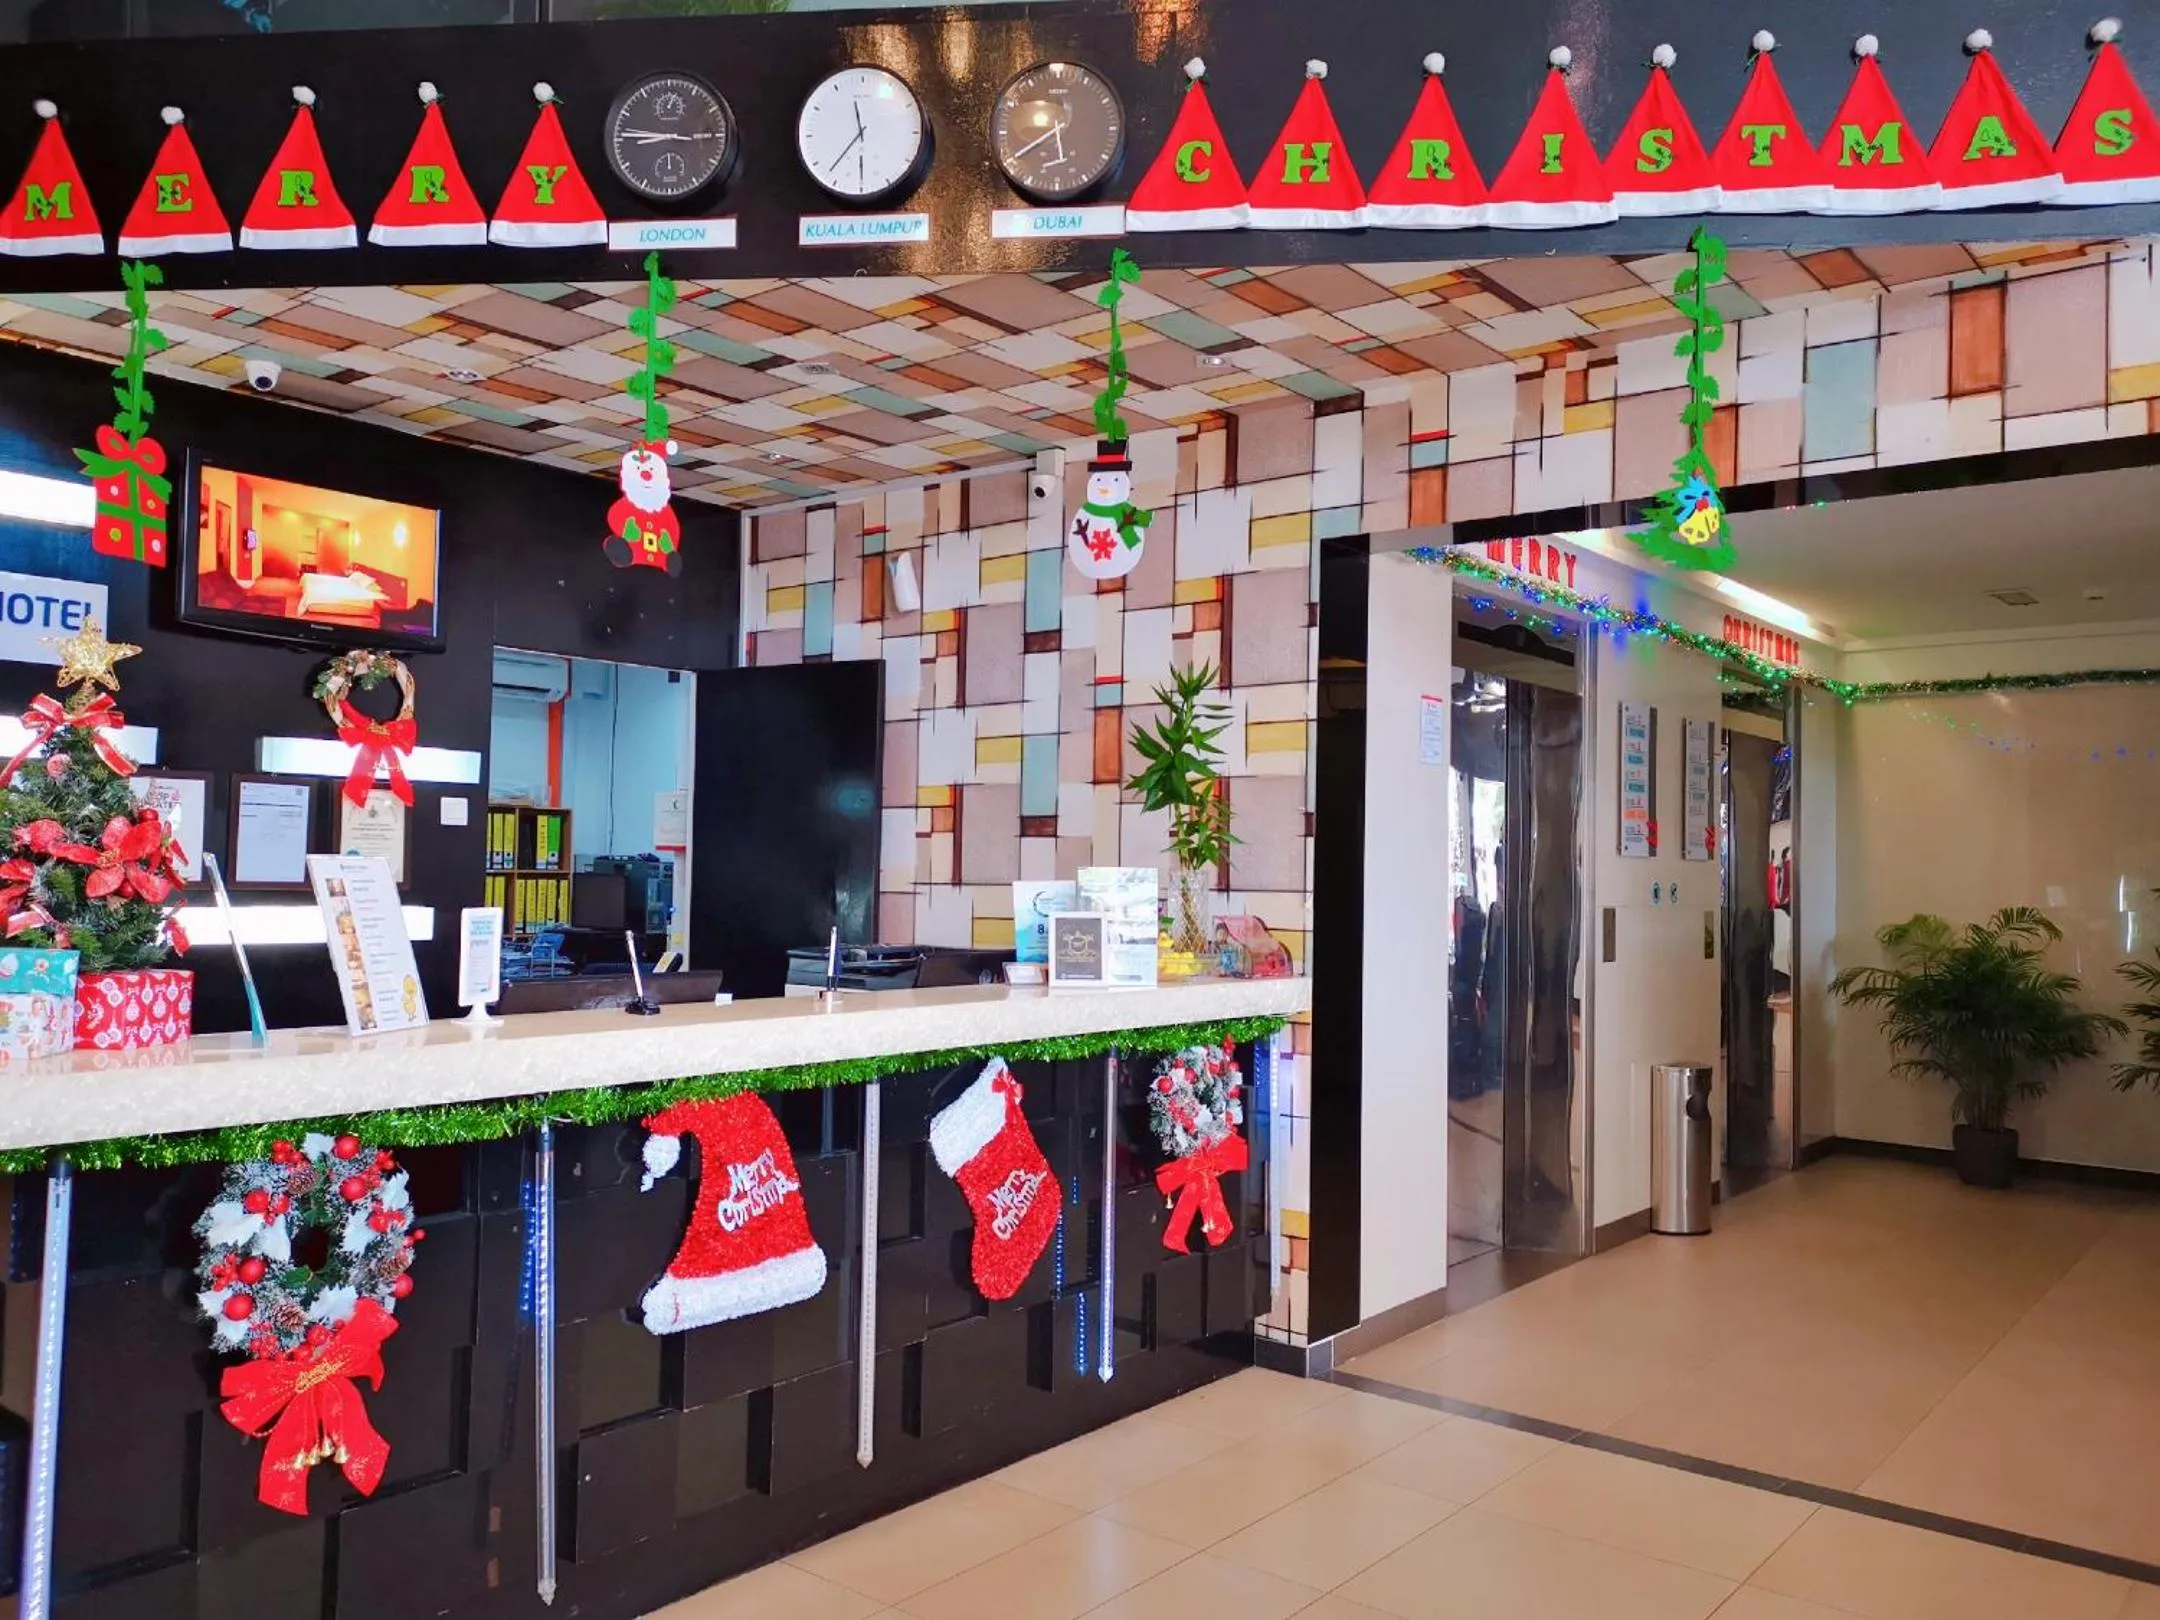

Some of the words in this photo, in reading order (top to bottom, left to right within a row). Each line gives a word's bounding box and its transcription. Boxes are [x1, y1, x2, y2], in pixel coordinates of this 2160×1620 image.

[640, 227, 707, 243] LONDON
[806, 221, 856, 237] KUALA
[1033, 215, 1083, 230] DUBAI
[1487, 536, 1577, 588] MERRY
[0, 591, 92, 631] OTE
[726, 1147, 786, 1200] Merry
[987, 1168, 1036, 1219] Merry
